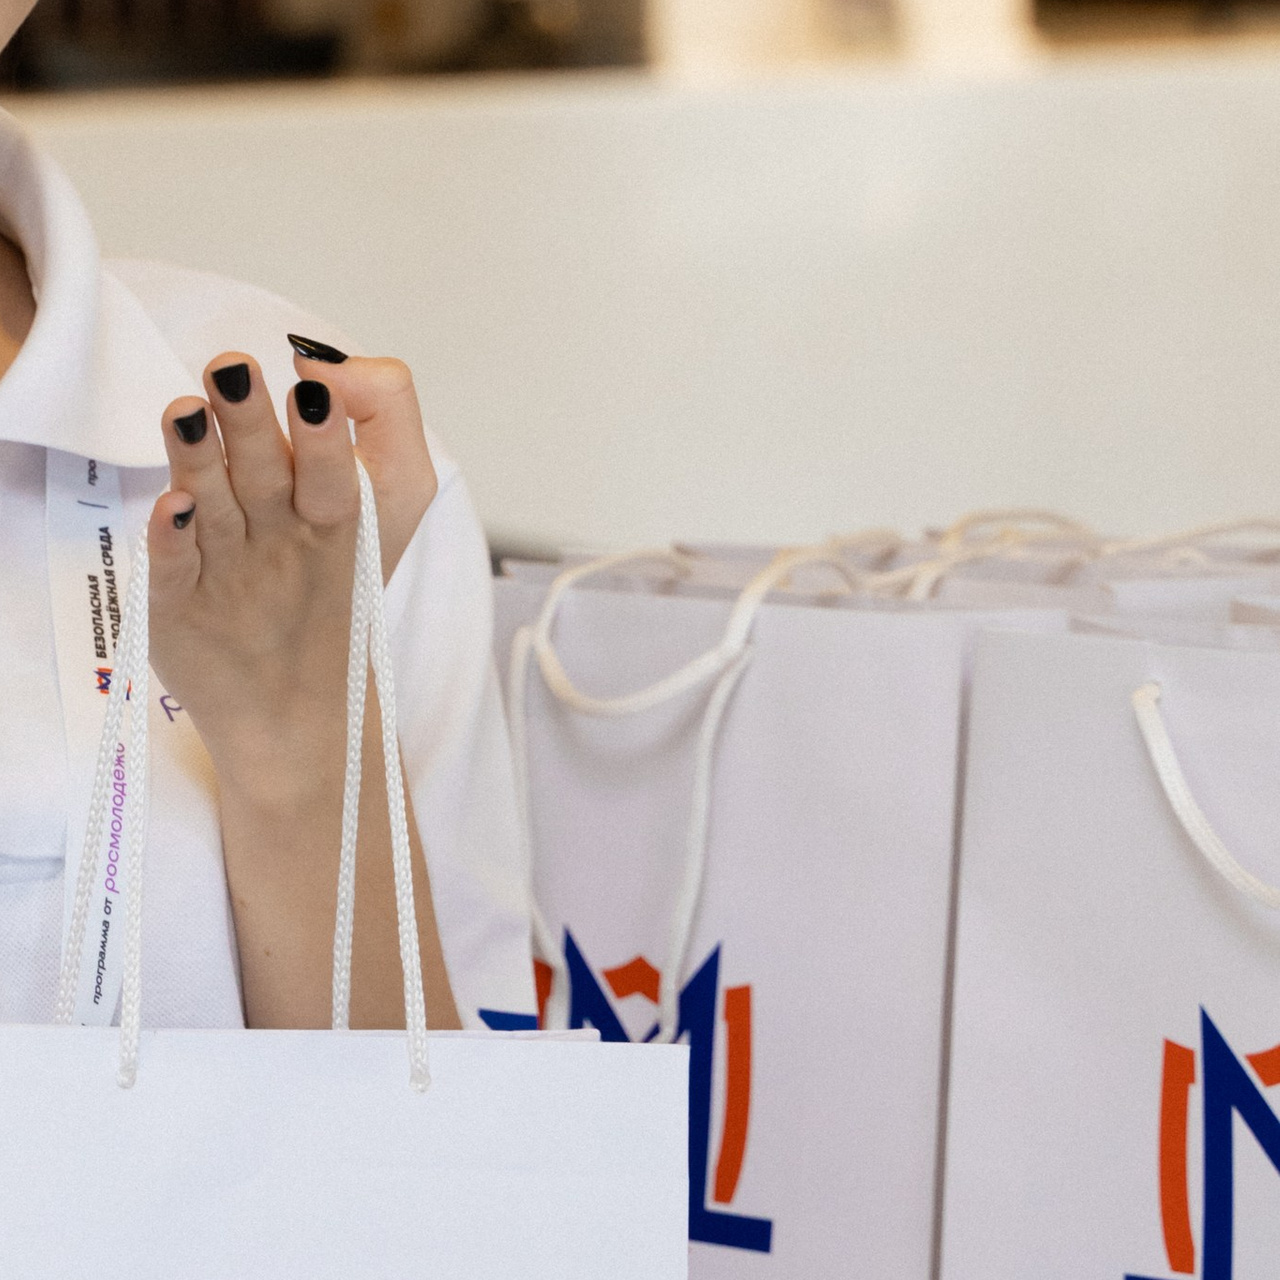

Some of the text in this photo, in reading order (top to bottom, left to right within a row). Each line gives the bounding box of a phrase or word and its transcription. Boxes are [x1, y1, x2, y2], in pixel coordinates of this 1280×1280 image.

[88, 574, 107, 659] БЕЗОПАСНАЯ
[98, 526, 121, 654] ЛОДЁЖНАЯ СРЕДА
[92, 919, 111, 1005] программа
[103, 897, 113, 916] от
